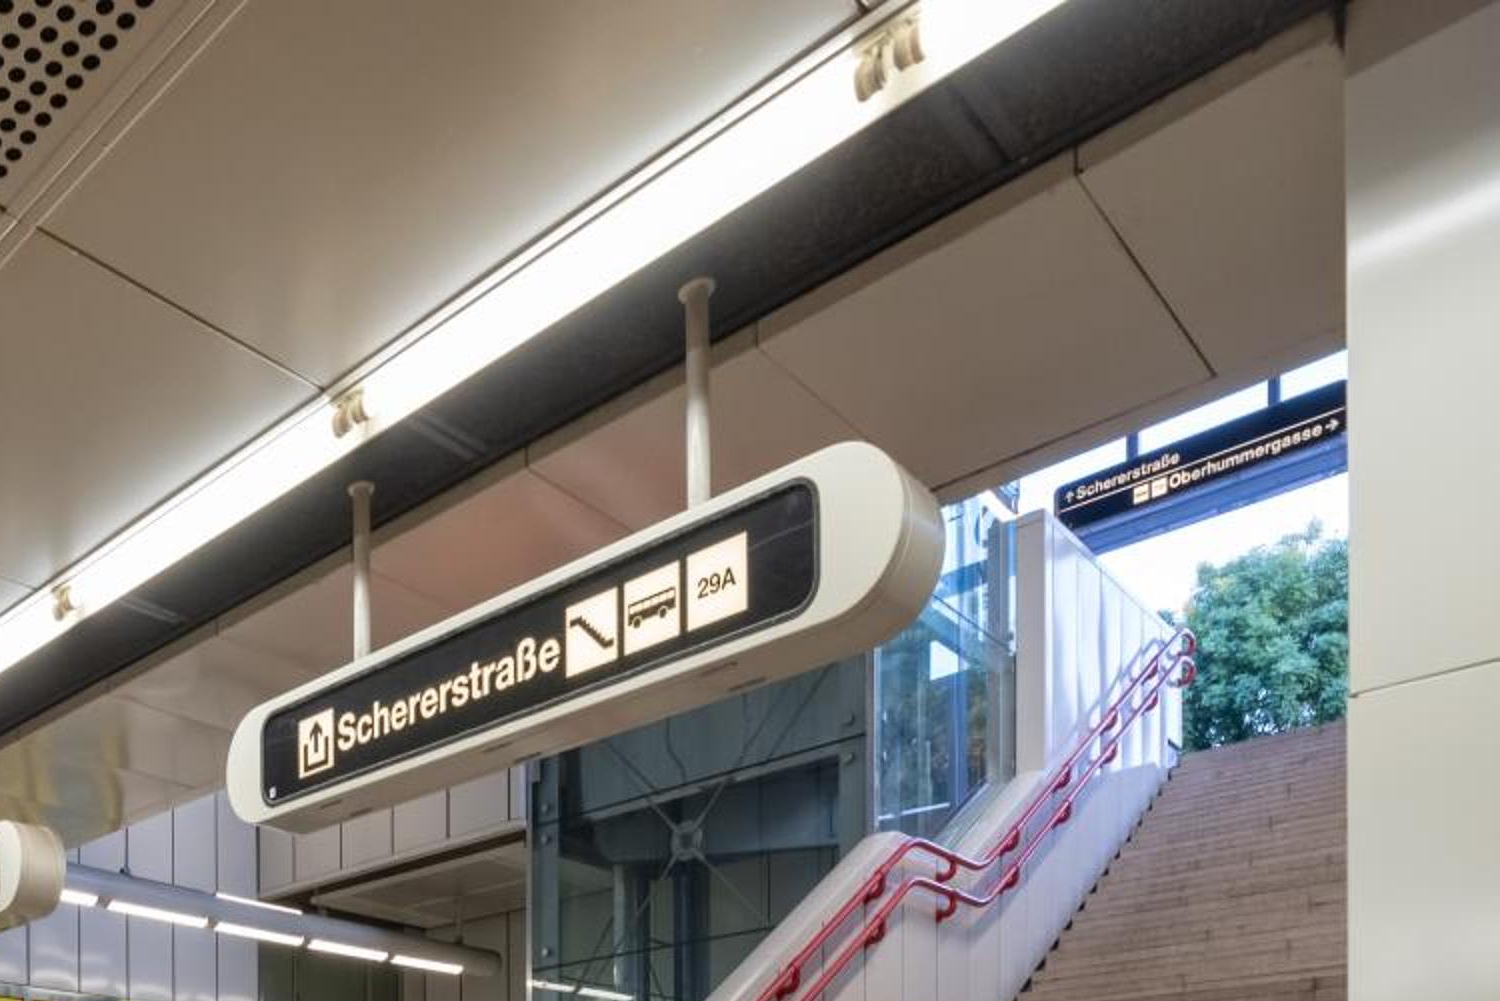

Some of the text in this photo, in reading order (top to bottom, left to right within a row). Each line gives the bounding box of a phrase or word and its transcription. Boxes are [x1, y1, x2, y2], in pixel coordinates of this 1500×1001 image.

[1076, 452, 1180, 500] Schererstraße
[1169, 424, 1323, 489] Oberhummergasse
[697, 567, 737, 600] 29A
[336, 636, 561, 751] Schererstraße
